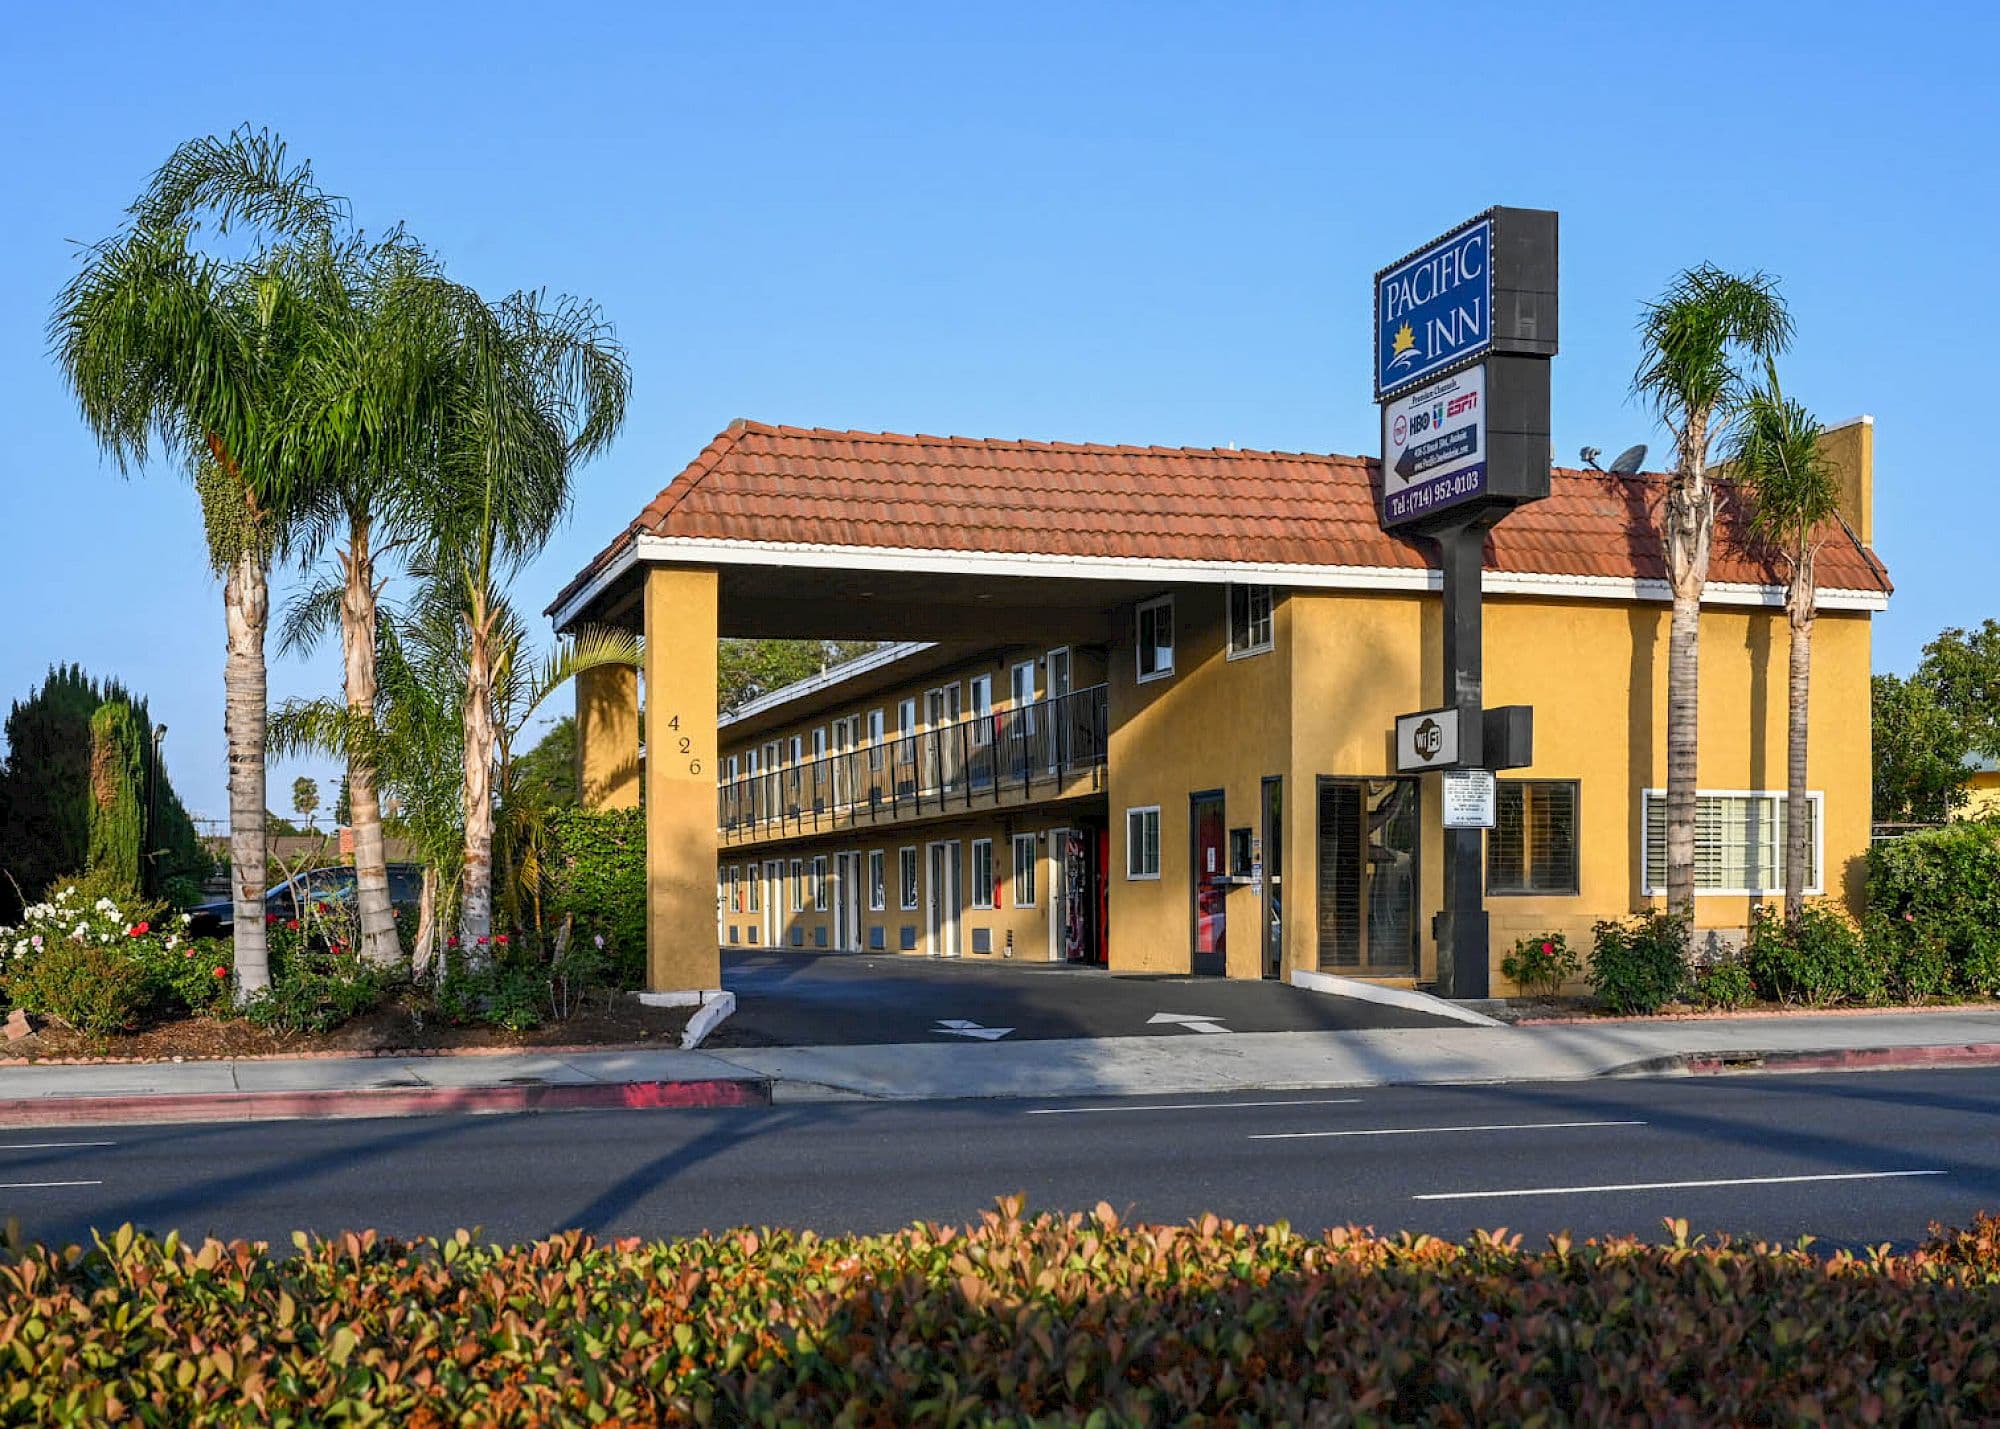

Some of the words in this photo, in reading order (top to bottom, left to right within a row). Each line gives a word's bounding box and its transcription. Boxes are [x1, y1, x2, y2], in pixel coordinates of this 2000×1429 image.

[1386, 235, 1482, 322] PACIFIC
[1425, 298, 1481, 360] INN
[1409, 411, 1430, 437] HBO
[1447, 391, 1477, 417] ESPN
[1434, 470, 1479, 502] 952-0103
